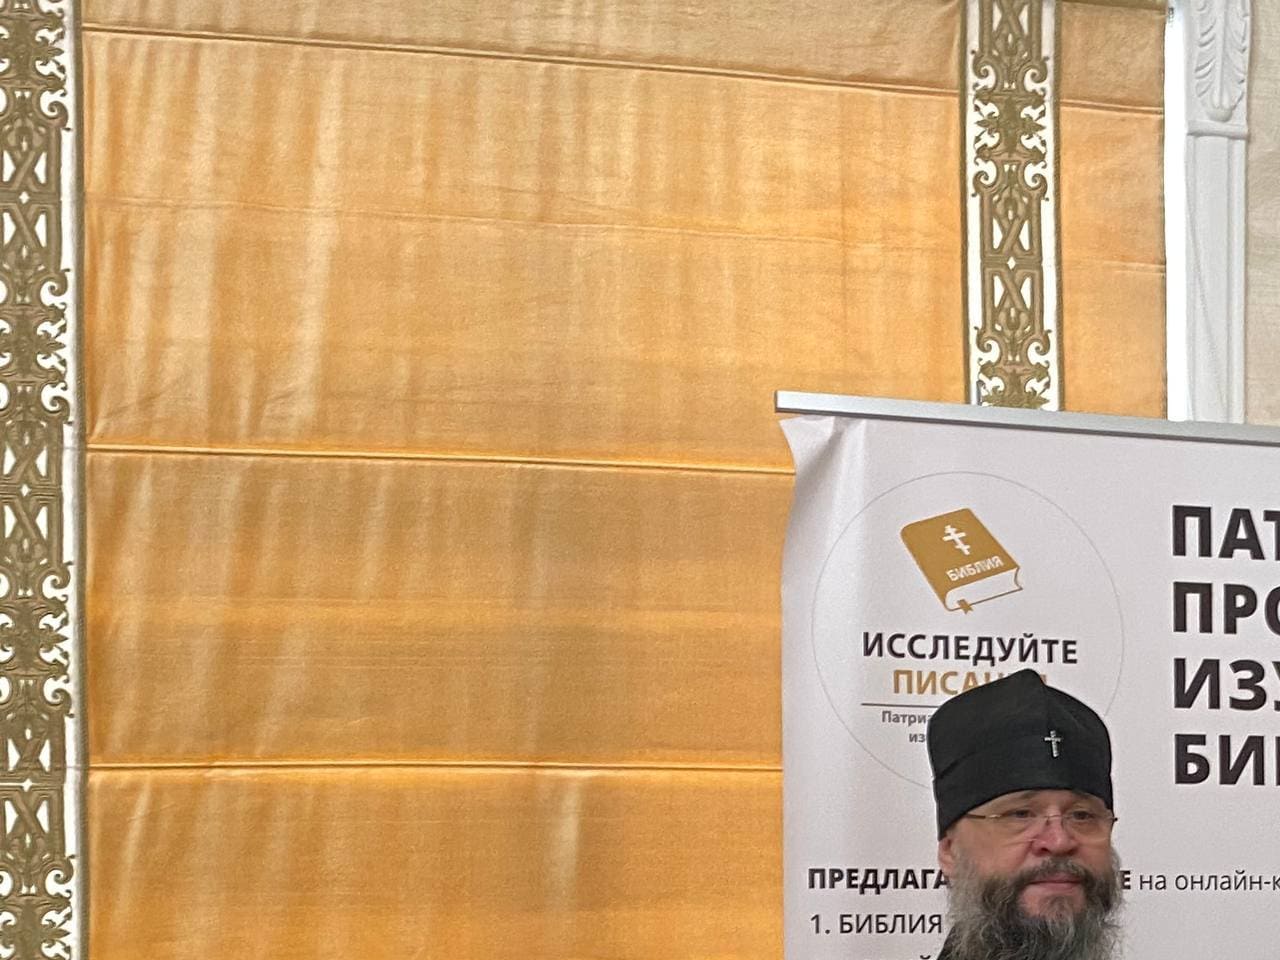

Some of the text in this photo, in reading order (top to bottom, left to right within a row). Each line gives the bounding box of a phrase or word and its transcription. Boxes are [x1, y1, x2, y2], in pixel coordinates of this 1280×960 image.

[946, 555, 1004, 582] БИБЛИЯ
[863, 631, 1078, 667] ИССЛЕДУЙТЕ
[893, 669, 1047, 695] ПИСА
[1139, 874, 1167, 891] на
[810, 914, 942, 934] 1. БИБЛИЯ
